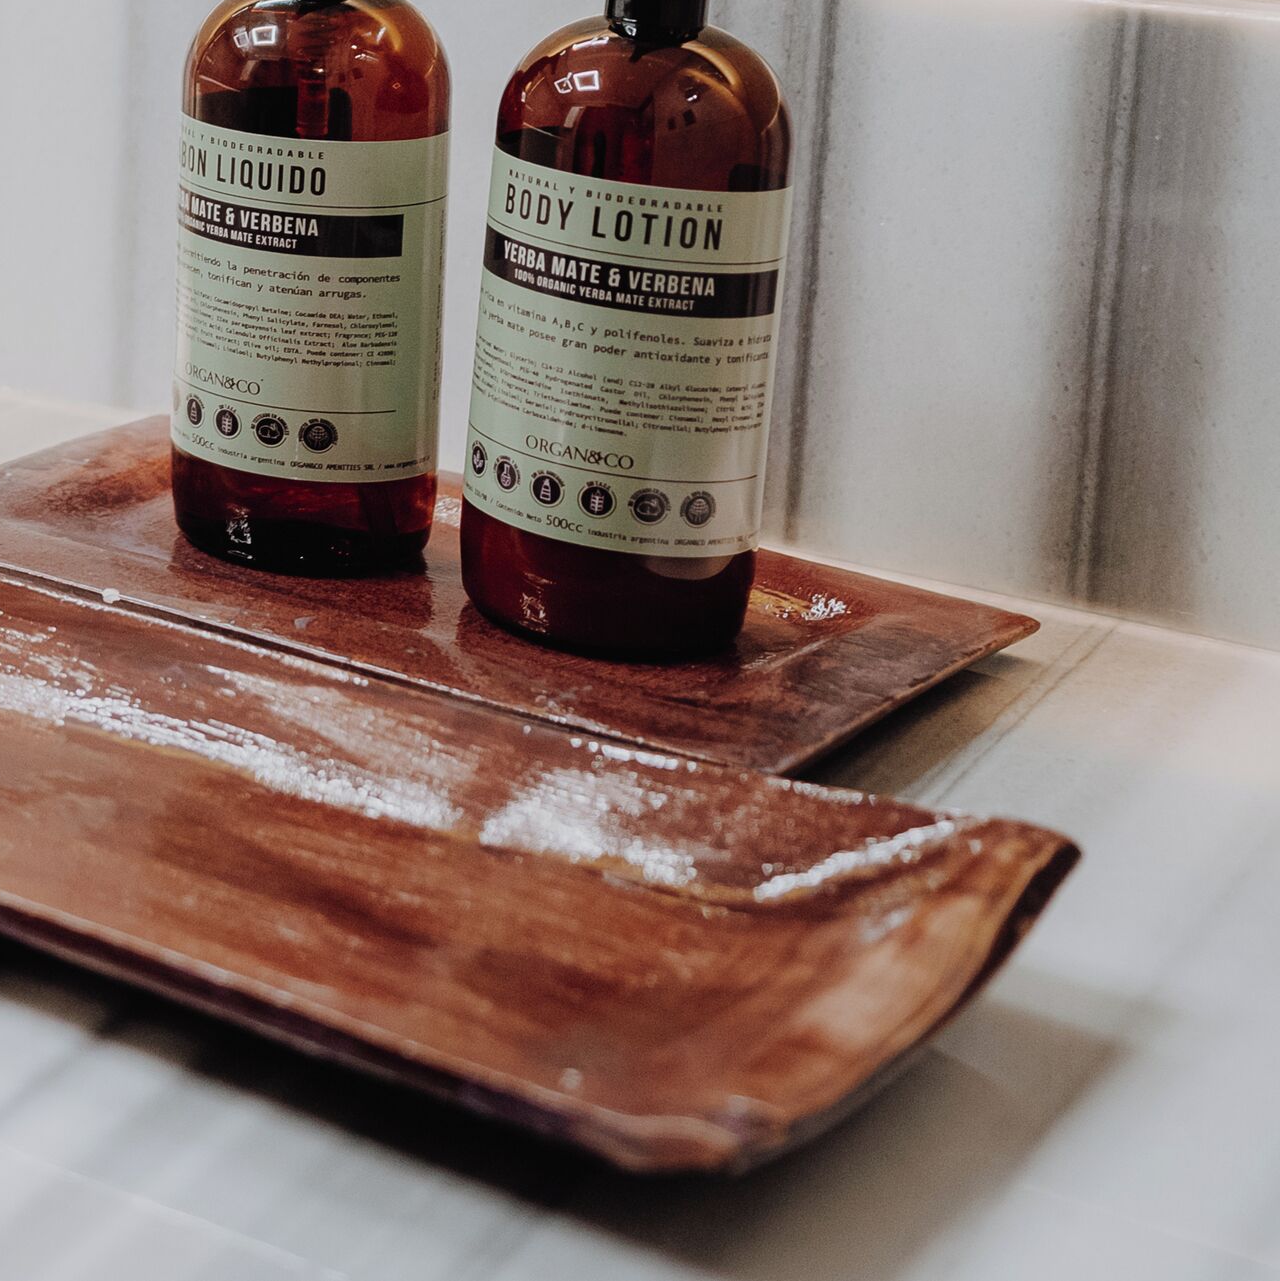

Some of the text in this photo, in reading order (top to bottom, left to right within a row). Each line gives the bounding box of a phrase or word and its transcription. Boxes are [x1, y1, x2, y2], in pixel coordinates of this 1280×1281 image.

[210, 136, 324, 160] BIODEGRADABLE
[216, 153, 326, 197] LIQUIDO
[509, 168, 723, 213] NATURAL Y BIODEGRADABLE
[191, 195, 221, 222] MATE
[226, 207, 235, 225] &
[240, 209, 319, 237] VERBENA
[206, 224, 297, 249] YERBA MATE EXTRACT
[505, 182, 723, 251] BODY LOTION
[207, 271, 366, 300] tonifican y atenúan arrugas.
[227, 260, 237, 271] la
[243, 266, 310, 282] penetración
[318, 273, 330, 283] de
[338, 274, 400, 285] componentes
[504, 239, 715, 296] YERBA MATE & VERBENA
[514, 268, 695, 311] 100% ORGANIC YERBA MATE EXTRACT
[507, 320, 525, 333] mate
[529, 328, 557, 342] posee
[562, 338, 587, 350] gran
[593, 344, 626, 356] poder
[634, 349, 711, 364] antioxidante
[715, 356, 721, 366] y
[508, 304, 547, 322] vitamina
[552, 318, 585, 333] A,B,C
[591, 327, 598, 336] y
[604, 328, 686, 346] polifenoles.
[693, 337, 734, 347] Suaviza
[185, 361, 261, 396] ORGAN&CO
[526, 433, 635, 470] ORGAN&CO
[546, 514, 584, 534] 500cc
